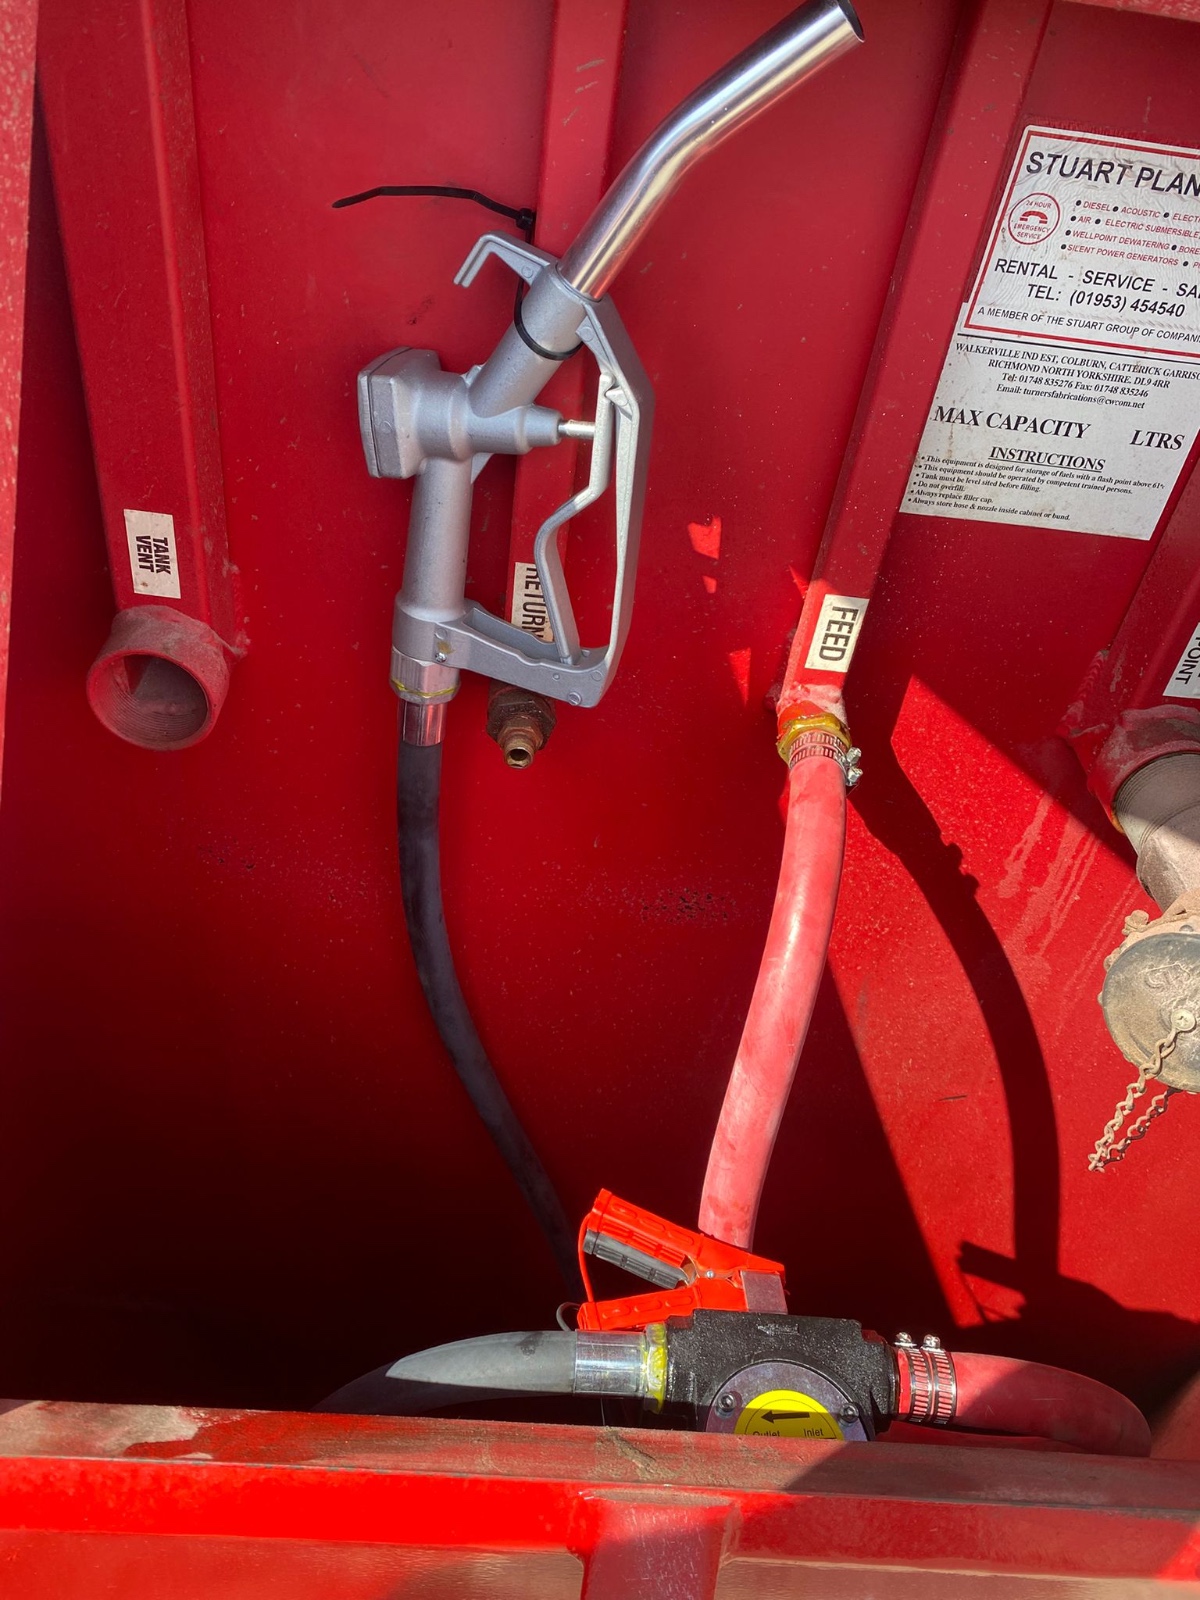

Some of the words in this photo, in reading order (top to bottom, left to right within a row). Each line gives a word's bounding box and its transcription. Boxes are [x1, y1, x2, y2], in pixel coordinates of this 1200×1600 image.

[1026, 151, 1133, 185] STUART
[1134, 167, 1200, 197] PLAN
[1083, 201, 1111, 211] DIESEL
[1121, 207, 1160, 218] ACOUSTIC
[1014, 223, 1050, 233] EMERGENCY
[1078, 216, 1091, 224] AIR
[1105, 219, 1144, 230] ELECTRIC
[1145, 224, 1200, 238] SUBMERSIBLE
[1073, 230, 1118, 242] WELLPOINT
[1119, 237, 1170, 250] DEWATERING
[1067, 244, 1095, 254] SILENT
[1096, 248, 1125, 258] POWER
[1126, 253, 1179, 266] GENERATORS
[994, 258, 1058, 280] RENTAL
[1082, 270, 1155, 292] SERVICE
[1027, 284, 1061, 302] TEL:
[1070, 289, 1126, 312] (01953)
[1130, 298, 1185, 317] 454540
[977, 307, 985, 315] A
[987, 308, 1028, 320] MEMBER
[1031, 314, 1044, 322] OF
[1046, 315, 1065, 325] THE
[1066, 318, 1104, 330] STUART
[1105, 323, 1140, 334] GROUP
[1141, 328, 1155, 337] OF
[956, 343, 1020, 358] WALKERVILLE
[1021, 351, 1039, 360] IND
[1040, 353, 1059, 364] EST,
[1060, 356, 1107, 370] COLBURN,
[1109, 362, 1162, 376] CATTERICK
[988, 359, 1040, 373] RICHMOND
[1040, 366, 1074, 377] NORTH
[1076, 370, 1132, 384] YORKSHIRE.
[1133, 377, 1152, 386] DL9
[1152, 379, 1170, 388] 4RR
[1002, 373, 1017, 382] Tel:
[1019, 375, 1043, 385] 01748
[1044, 378, 1073, 389] 835276
[1075, 381, 1092, 391] Fax:
[1094, 384, 1119, 394] 01748
[1120, 387, 1149, 397] 835246
[996, 384, 1022, 394] Email:
[1023, 388, 1145, 409] turnersfabrications@cwcom.net
[932, 405, 984, 427] MAX
[986, 412, 1092, 439] CAPACITY
[1129, 429, 1186, 450] LTRS
[926, 455, 941, 463] This
[942, 459, 977, 468] equipment
[984, 462, 1014, 472] designed
[1014, 466, 1025, 474] for
[1026, 468, 1050, 477] storage
[1051, 469, 1059, 478] of
[1059, 471, 1075, 479] fuels
[1076, 473, 1091, 481] with
[1097, 475, 1113, 484] flash
[1114, 479, 1131, 487] point
[989, 446, 1106, 471] INSTRUCTIONS
[921, 472, 938, 480] Tank
[965, 477, 981, 485] level
[982, 479, 997, 487] sited
[998, 480, 1019, 489] before
[1020, 483, 1041, 493] filling.
[939, 467, 973, 476] equipment
[975, 470, 997, 478] should
[1007, 474, 1036, 483] operated
[1046, 479, 1081, 488] competent
[1081, 483, 1105, 491] trained
[1105, 486, 1133, 495] persons.
[940, 484, 965, 492] overfill.
[912, 497, 935, 505] Always
[998, 506, 1018, 514] inside
[1019, 509, 1042, 517] cabinet
[915, 489, 938, 497] Always
[939, 491, 962, 500] replace
[963, 493, 979, 501] filler
[135, 535, 154, 573] VENT
[153, 537, 171, 575] TANK
[819, 606, 859, 661] FEED
[804, 1428, 824, 1437] Inlet
